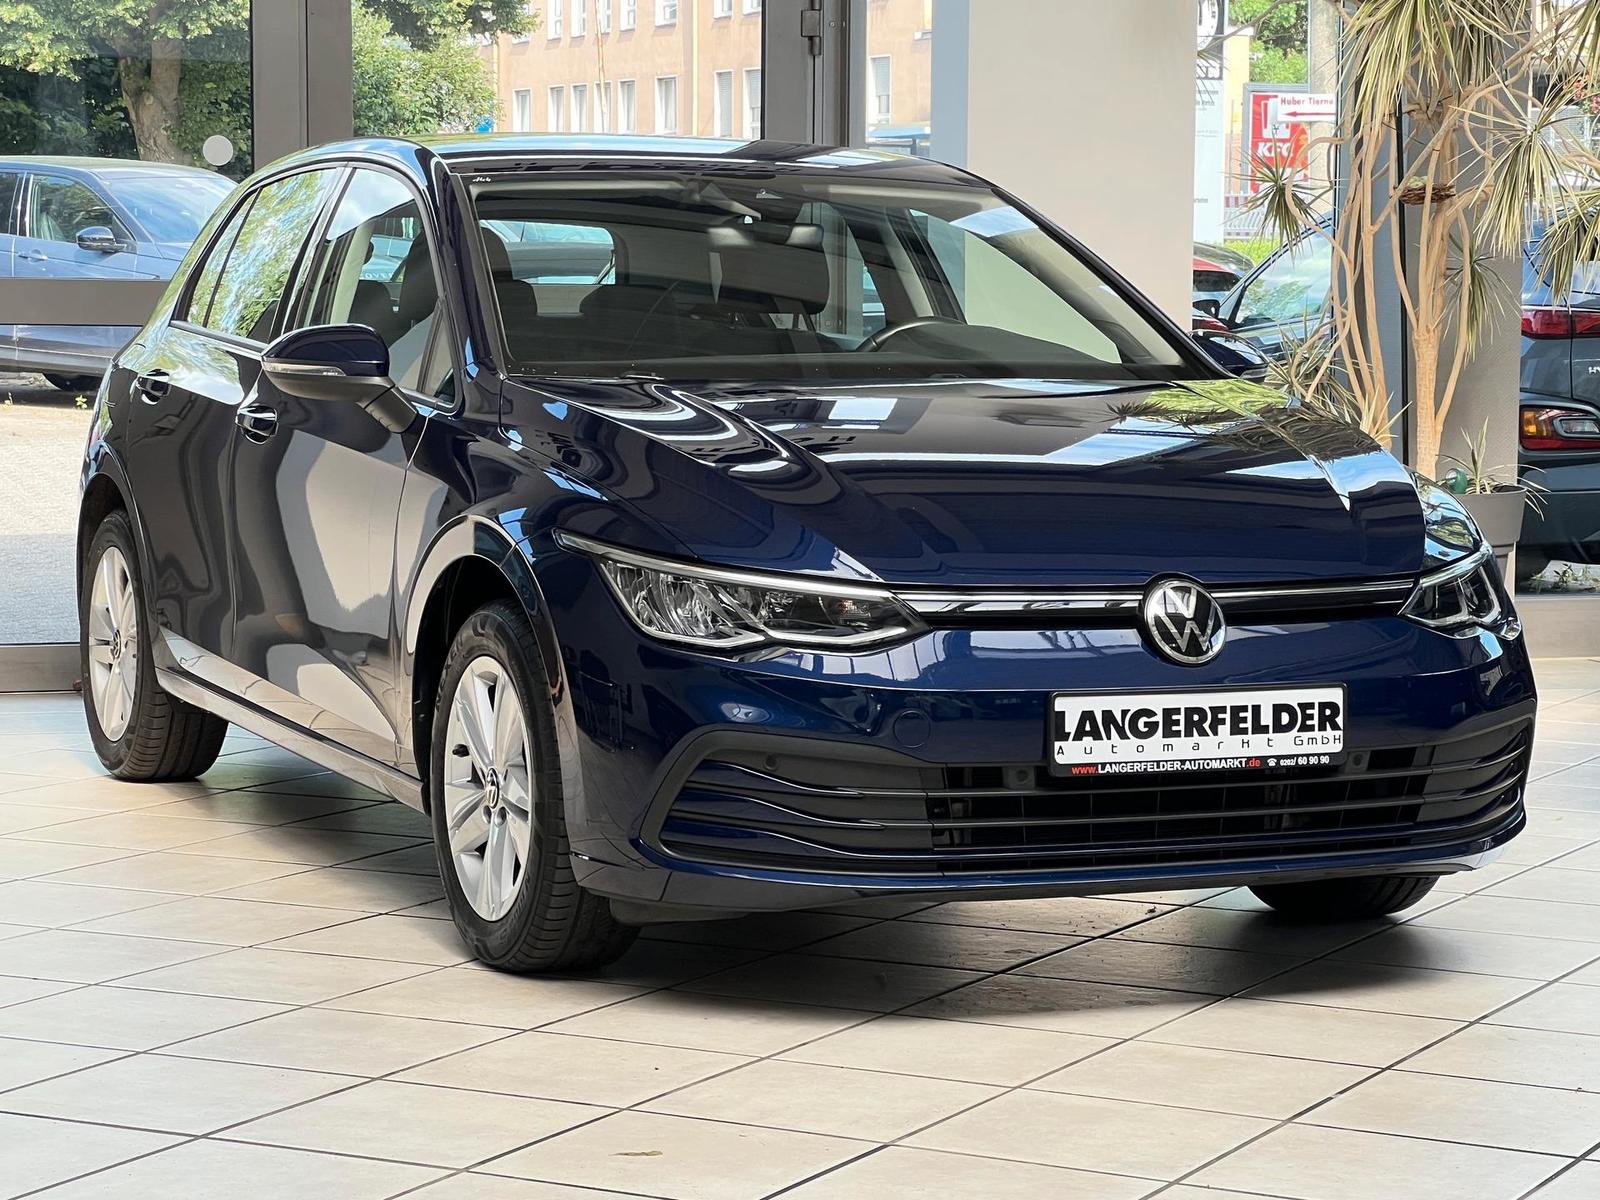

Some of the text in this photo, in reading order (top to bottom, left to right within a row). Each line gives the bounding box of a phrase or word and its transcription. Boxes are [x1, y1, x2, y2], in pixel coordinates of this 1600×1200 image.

[1280, 96, 1305, 106] Huber
[1256, 142, 1294, 157] KFC
[1054, 701, 1342, 742] LANGERFELDER
[1293, 734, 1342, 747] GmbH
[1071, 757, 1262, 775] www.LANGERFELDER-AUTOMARKT.de
[1297, 757, 1308, 766] 60
[1308, 756, 1319, 765] 90
[1319, 755, 1330, 764] 90
